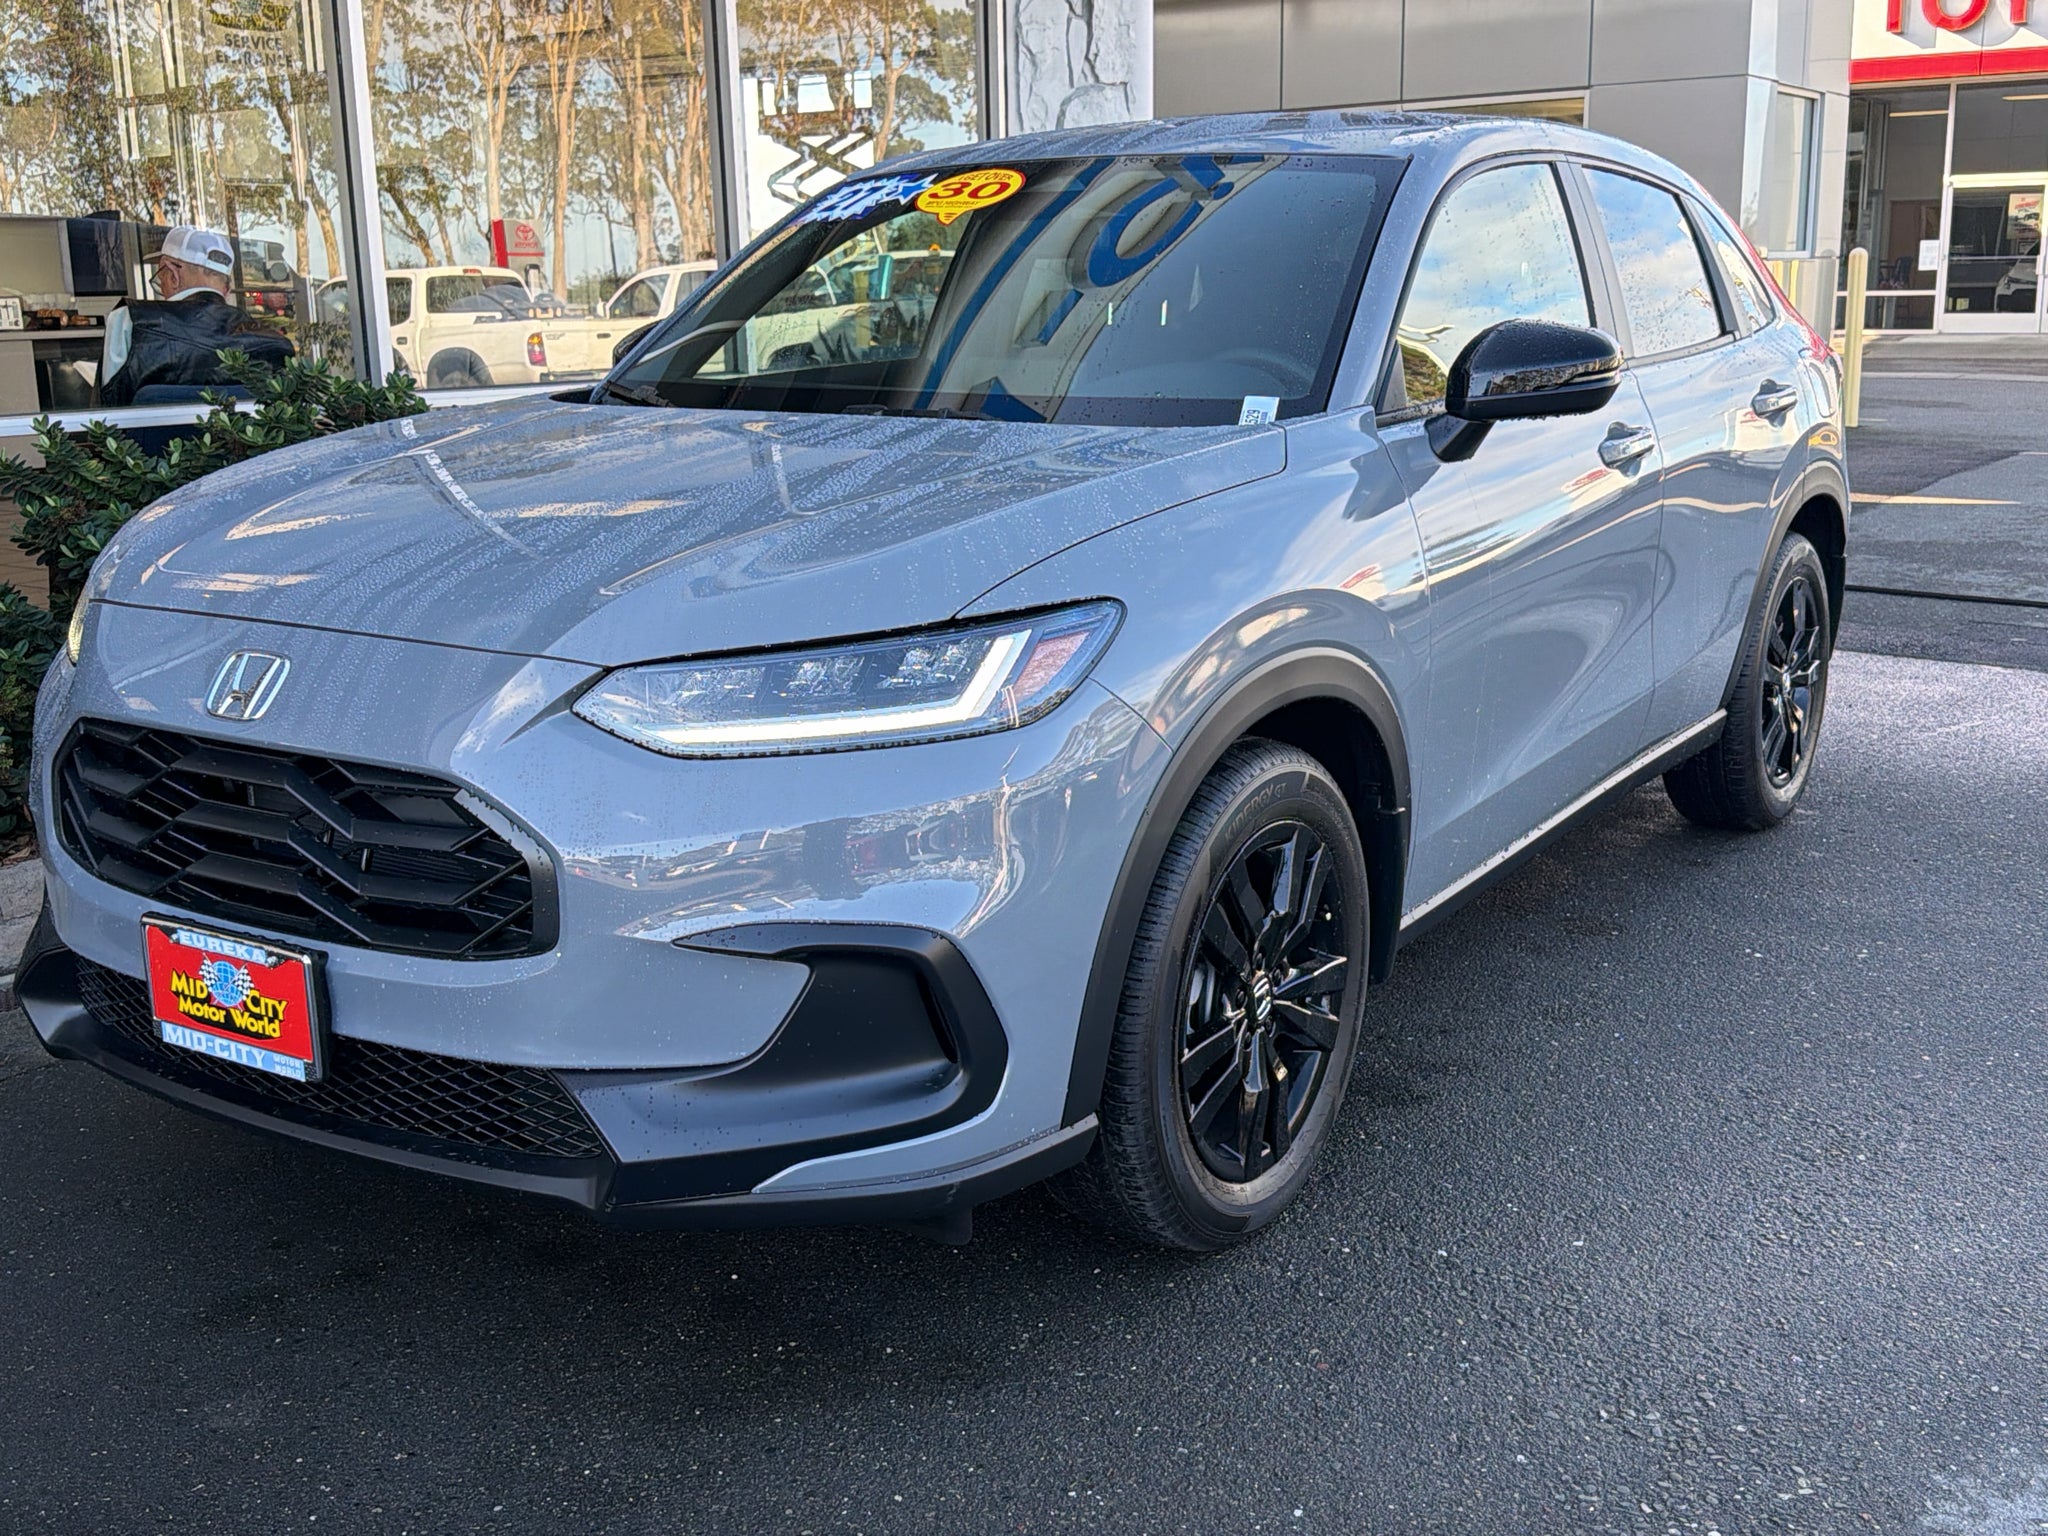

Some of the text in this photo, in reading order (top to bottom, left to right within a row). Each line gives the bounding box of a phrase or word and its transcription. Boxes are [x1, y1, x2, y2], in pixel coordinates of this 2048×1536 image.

[224, 33, 283, 51] SERVICE
[927, 181, 1011, 199] 30
[178, 931, 267, 963] EUREKA
[171, 970, 288, 1020] MID CITY
[179, 994, 281, 1038] Motor World
[164, 1024, 266, 1068] MID-CITY
